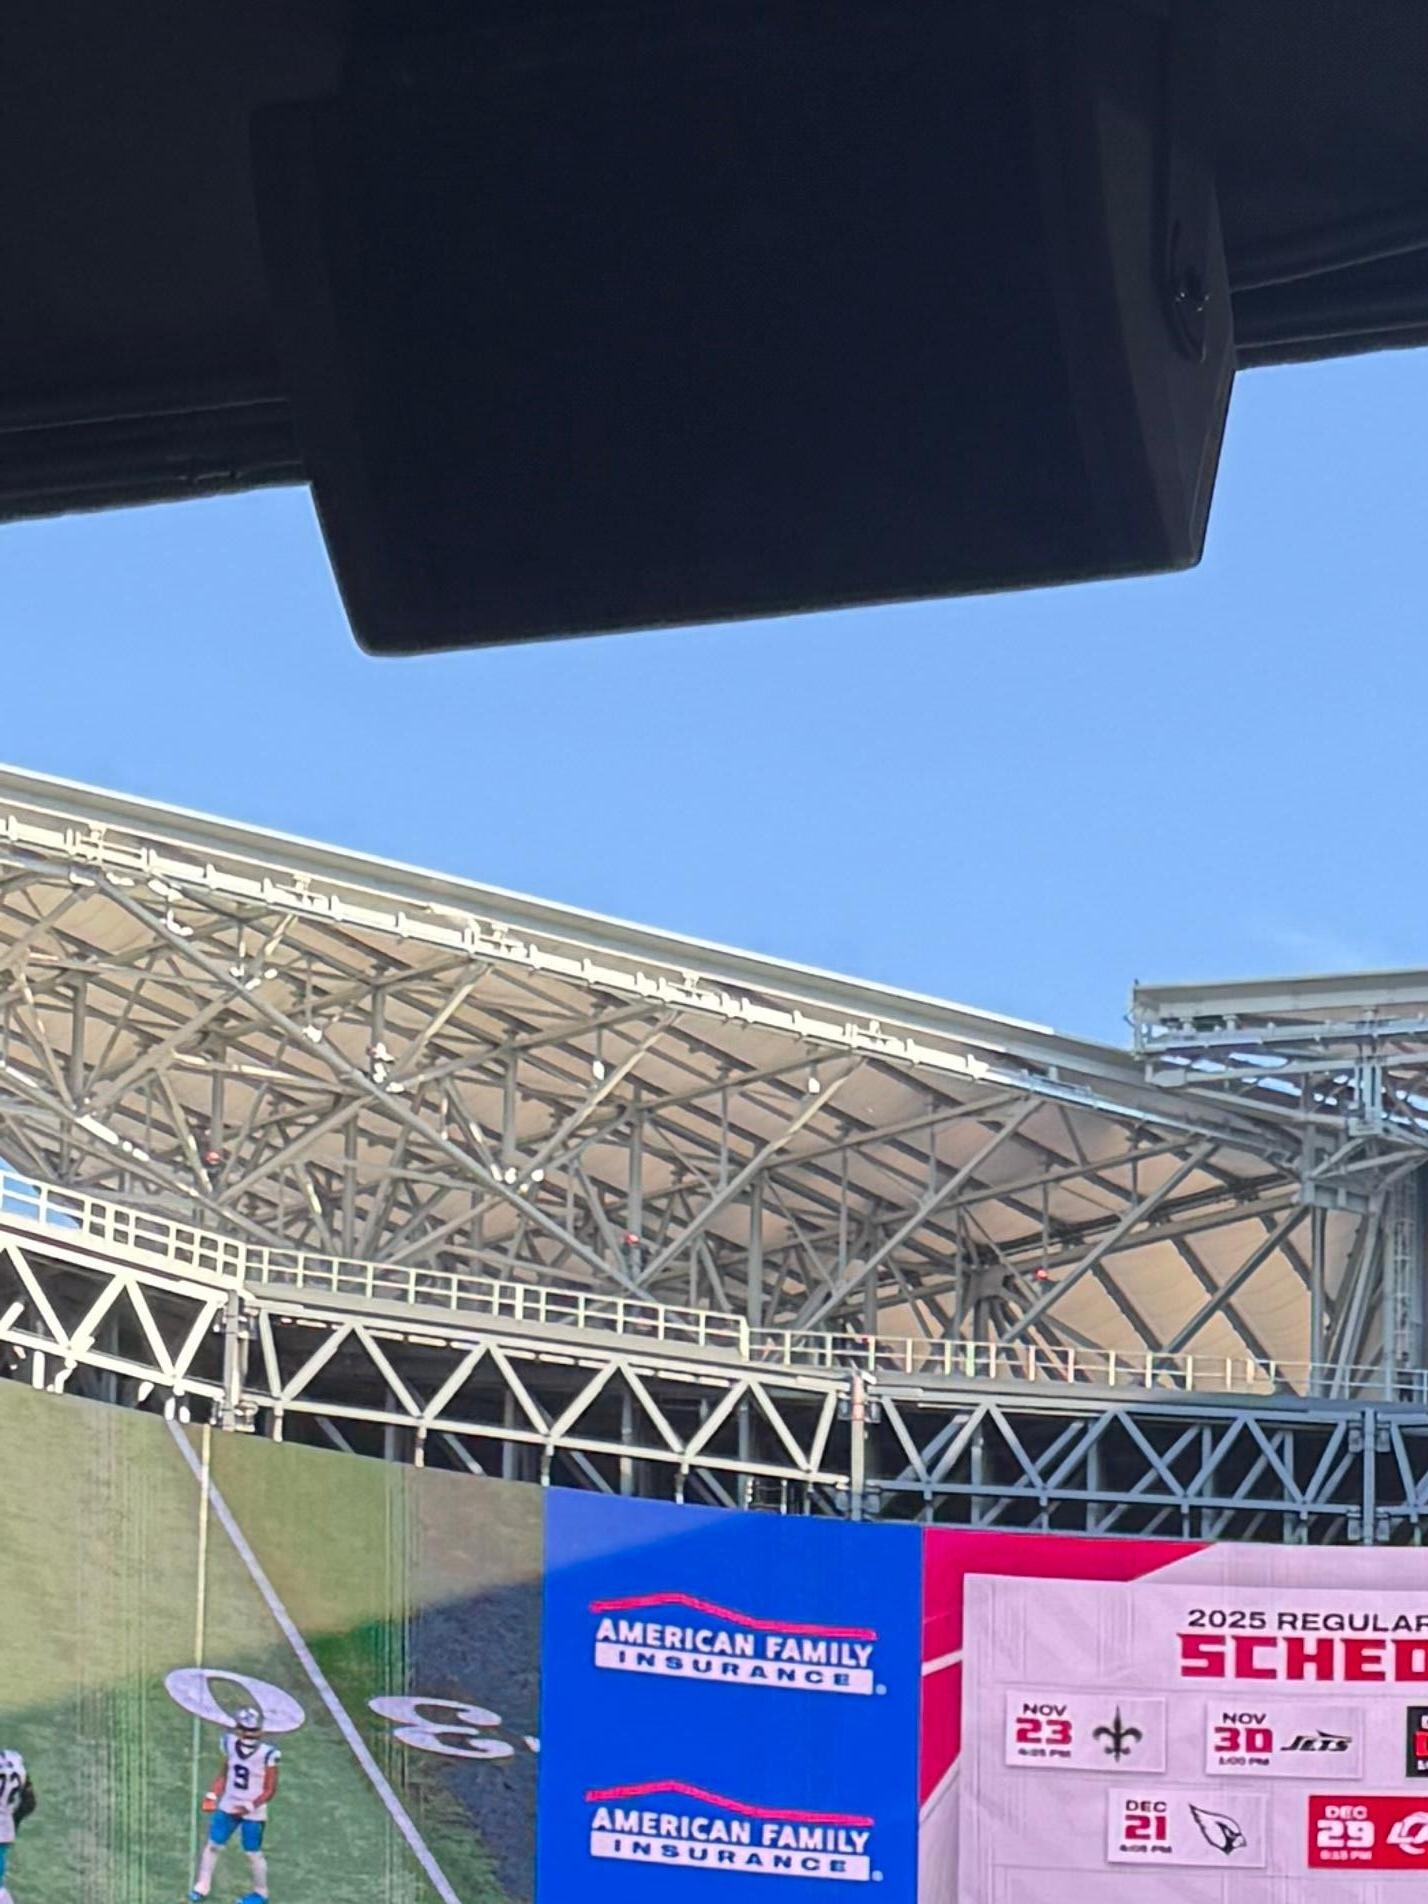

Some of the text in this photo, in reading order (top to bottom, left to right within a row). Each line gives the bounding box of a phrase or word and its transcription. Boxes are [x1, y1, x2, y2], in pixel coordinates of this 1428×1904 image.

[1187, 1610, 1266, 1630] 2025
[596, 1618, 874, 1668] AMERICAN FAMILY
[617, 1650, 853, 1689] INSURANCE
[1023, 1703, 1067, 1717] NOV
[1222, 1712, 1267, 1725] NOV
[1016, 1717, 1072, 1745] 23
[1214, 1726, 1273, 1753] 30
[1280, 1730, 1352, 1752] JETS
[1125, 1800, 1168, 1813] DEC
[1325, 1805, 1368, 1820] DEC
[591, 1807, 871, 1854] AMERICAN FAMILY
[1124, 1814, 1167, 1841] 21
[1316, 1819, 1375, 1848] 29
[612, 1839, 850, 1874] INSURANCE
